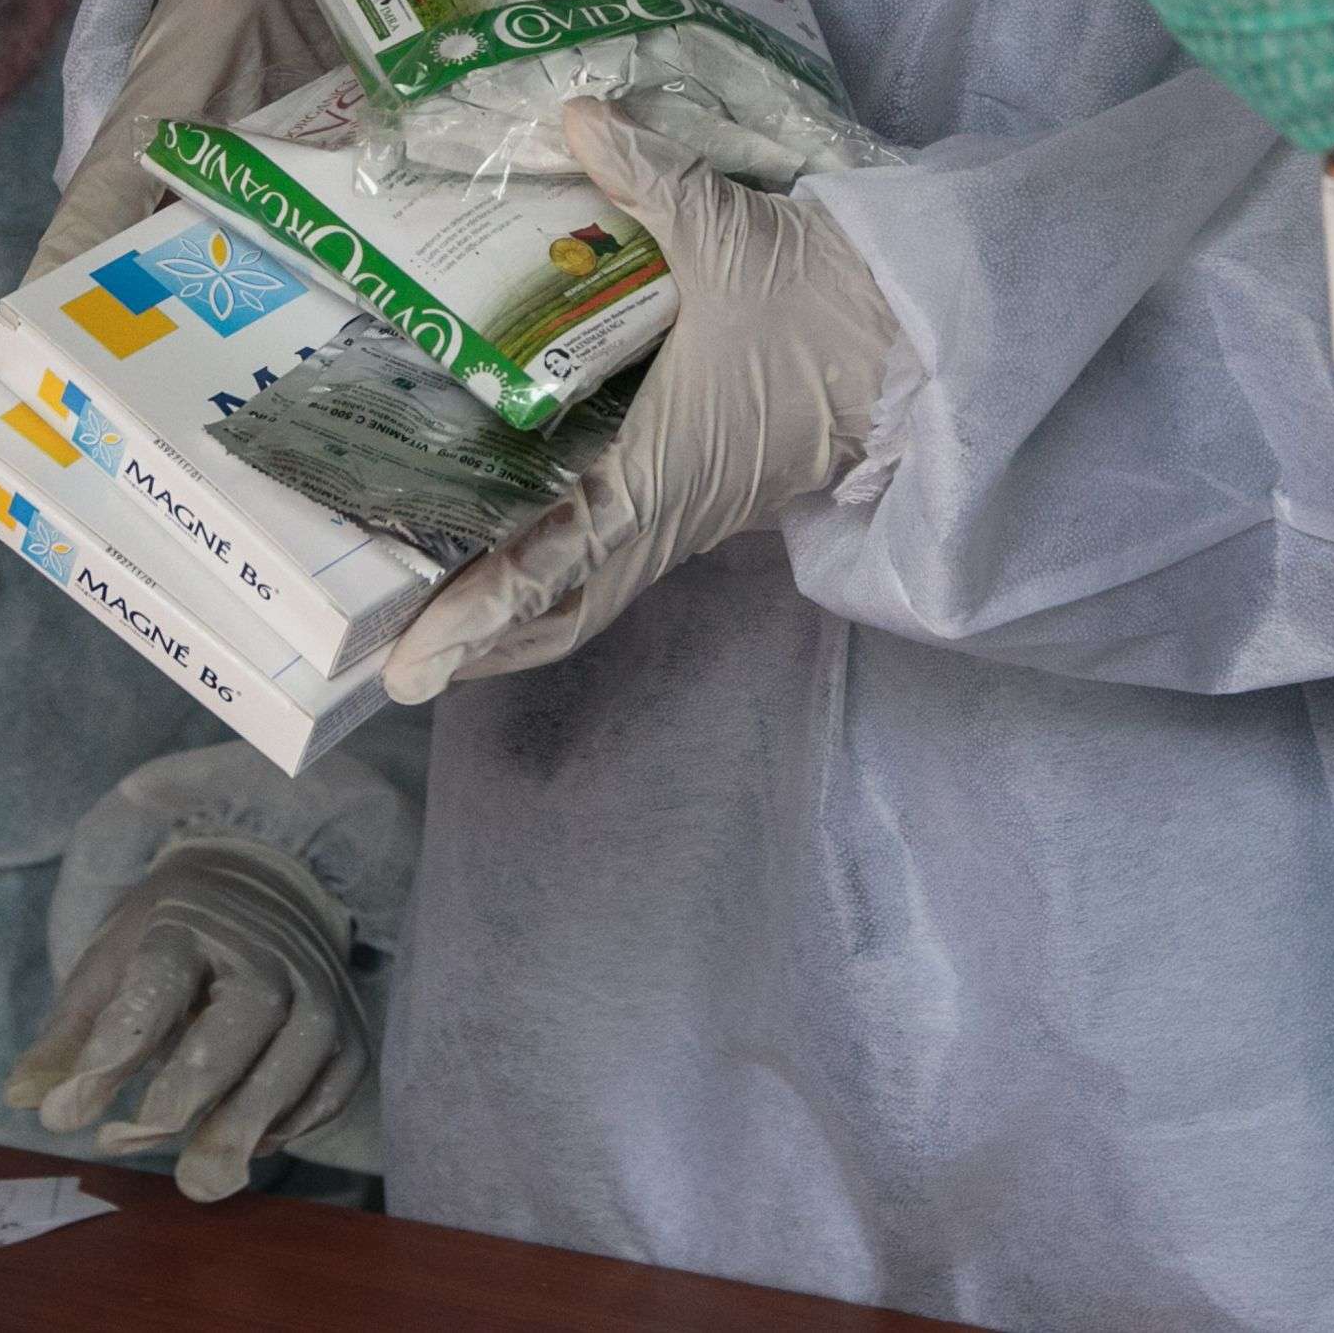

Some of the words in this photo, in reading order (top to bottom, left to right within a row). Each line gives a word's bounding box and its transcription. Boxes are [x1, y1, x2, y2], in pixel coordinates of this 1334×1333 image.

[329, 406, 353, 421] 500
[355, 414, 366, 425] C
[367, 418, 429, 452] VITAMINE
[458, 453, 483, 468] 500
[484, 462, 495, 473] C
[124, 459, 232, 564] MAGNÉ
[76, 568, 190, 669] MAGNÉ
